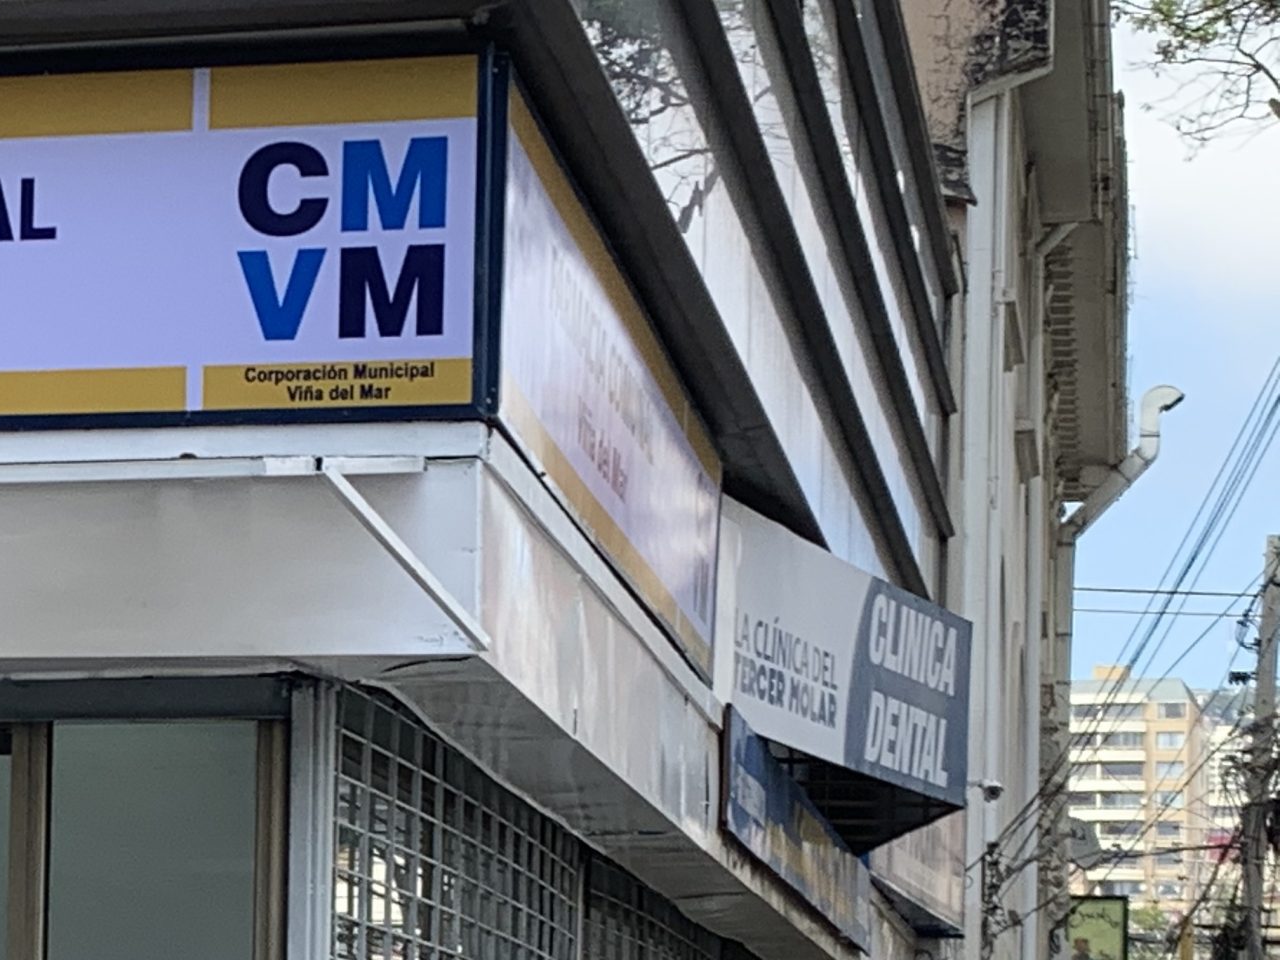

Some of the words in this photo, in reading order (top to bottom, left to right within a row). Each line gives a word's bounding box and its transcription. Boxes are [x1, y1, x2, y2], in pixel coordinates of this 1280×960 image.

[244, 365, 348, 385] Corporación
[353, 362, 435, 382] Municipal
[287, 384, 324, 402] Viña
[329, 384, 354, 400] del
[359, 383, 391, 399] Mar
[734, 606, 751, 653] LA
[754, 616, 809, 680] CLÍNICA
[812, 646, 838, 691] DEL
[870, 593, 957, 696] CLINICA
[733, 650, 786, 709] TERCER
[787, 676, 837, 729] MOLAR
[864, 688, 948, 788] DENTAL
